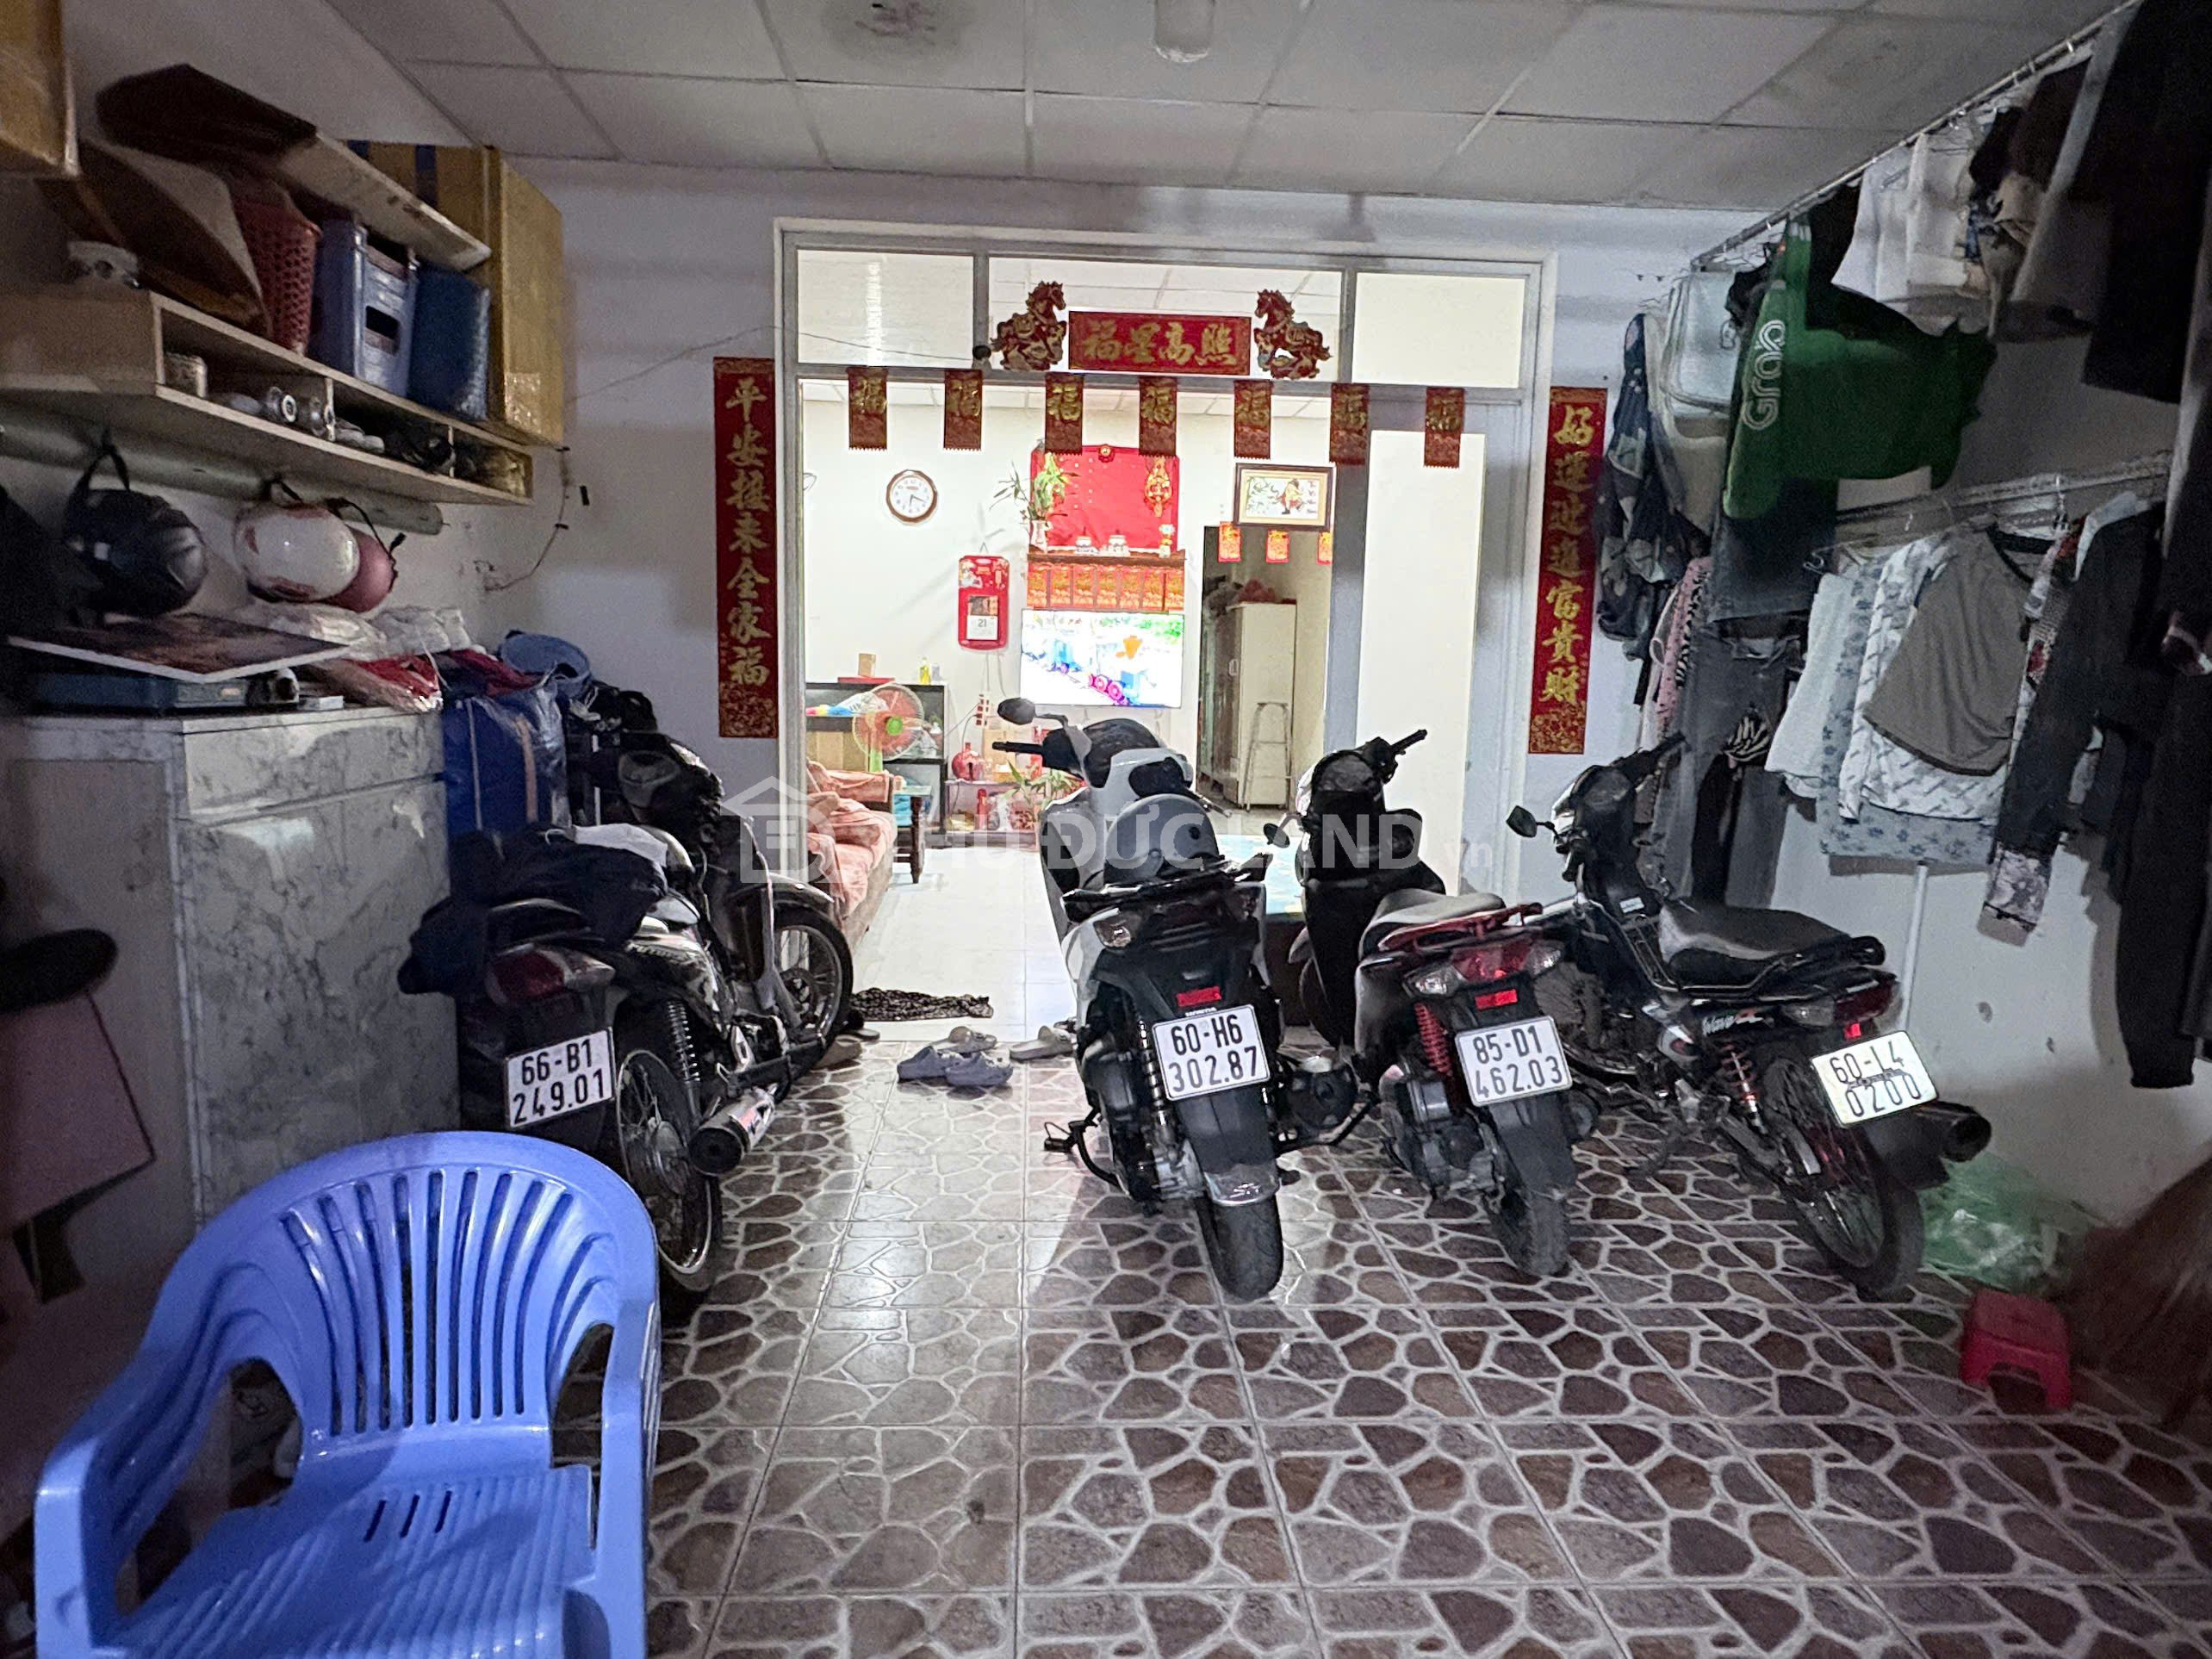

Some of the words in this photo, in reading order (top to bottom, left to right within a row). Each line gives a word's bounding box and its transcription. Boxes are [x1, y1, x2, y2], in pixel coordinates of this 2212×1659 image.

[1742, 320, 1786, 431] Grab
[1171, 1014, 1243, 1056] 60-H6
[1473, 1025, 1542, 1064] 85-D1
[521, 1039, 592, 1085] 66-B1
[1168, 1045, 1258, 1092] 302.87
[1476, 1055, 1563, 1098] 462.03
[513, 1068, 604, 1124] 249.01
